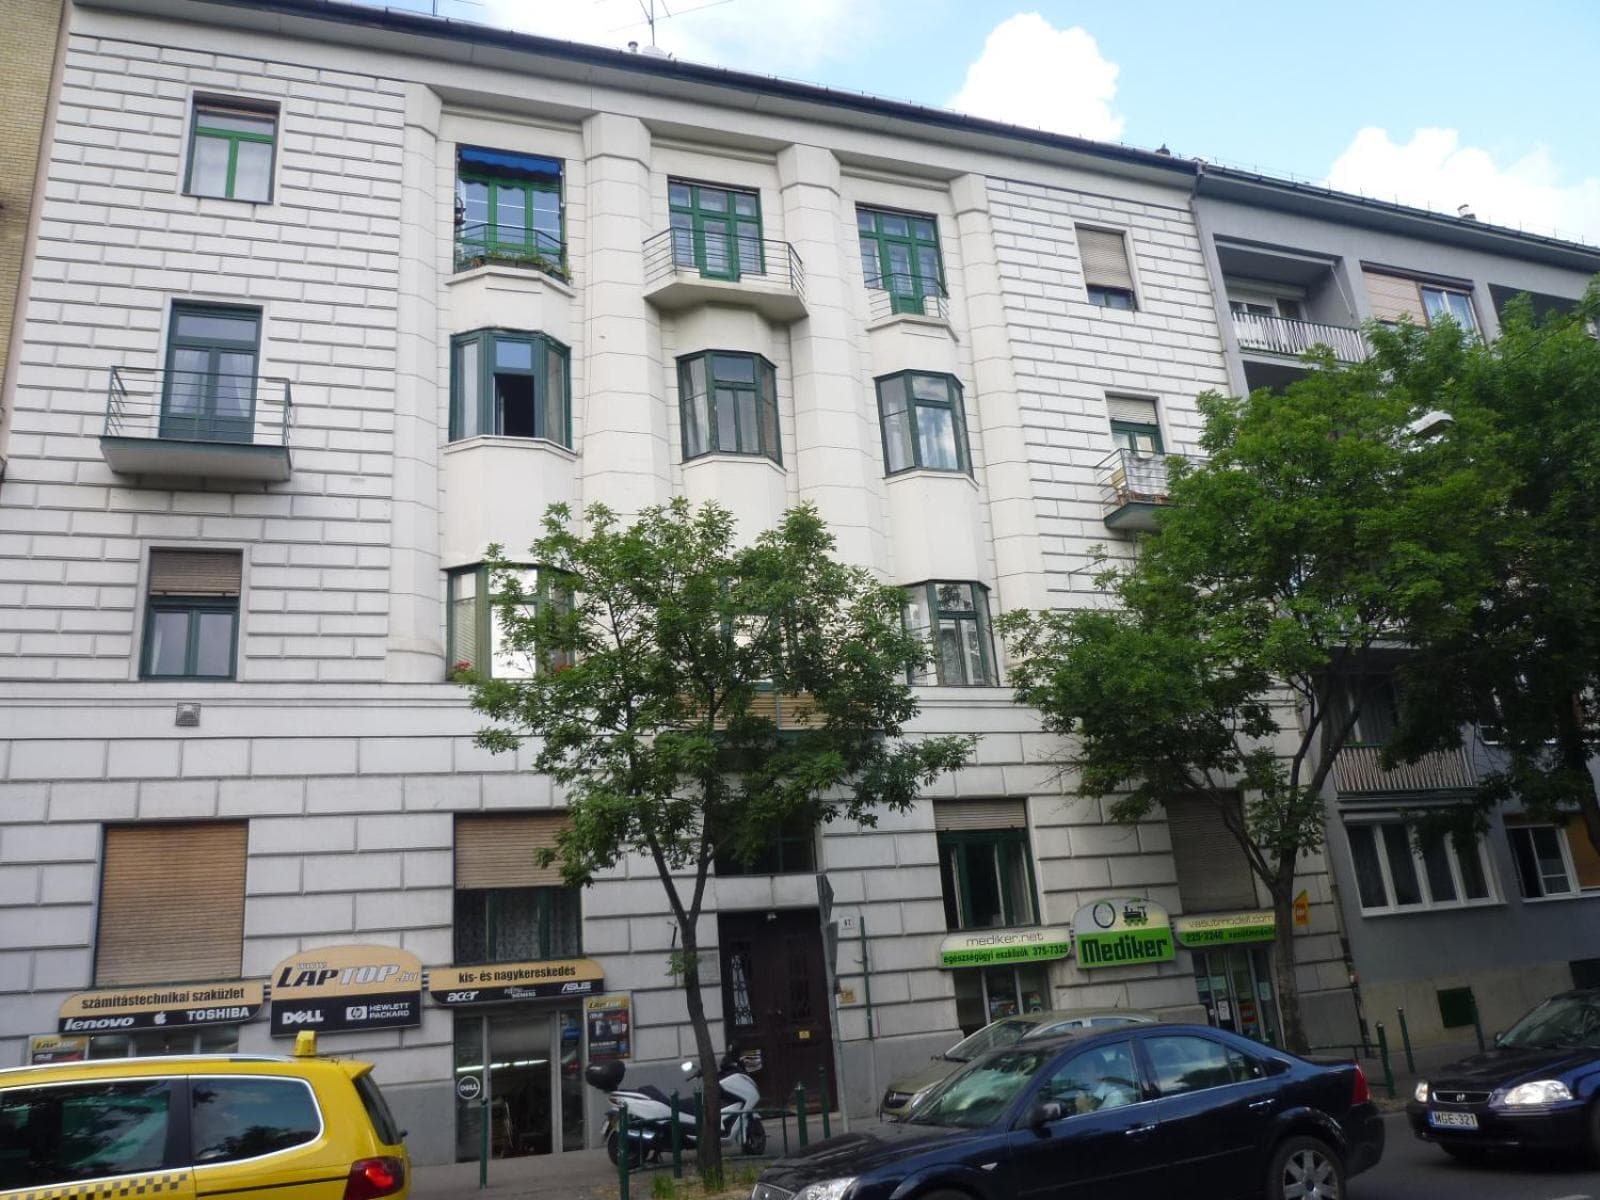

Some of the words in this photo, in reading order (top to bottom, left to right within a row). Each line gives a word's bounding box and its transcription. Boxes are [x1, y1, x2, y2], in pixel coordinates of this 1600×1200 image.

[965, 932, 1044, 947] mediker.net
[1081, 934, 1168, 963] Mediker
[458, 972, 478, 983] kis-
[479, 970, 492, 982] és
[493, 965, 576, 982] nagykereskedés
[560, 981, 592, 991] ASUS
[81, 990, 190, 1009] számítástechnikai
[192, 986, 245, 1002] szaküzlet
[447, 990, 480, 1002] acer
[186, 1006, 251, 1022] TOSHIBA
[369, 1002, 410, 1011] HEWLETT
[282, 1009, 324, 1025] DELL
[369, 1010, 411, 1019] PACKARD
[64, 1017, 135, 1031] lenovo
[1434, 1111, 1476, 1126] MGE-321
